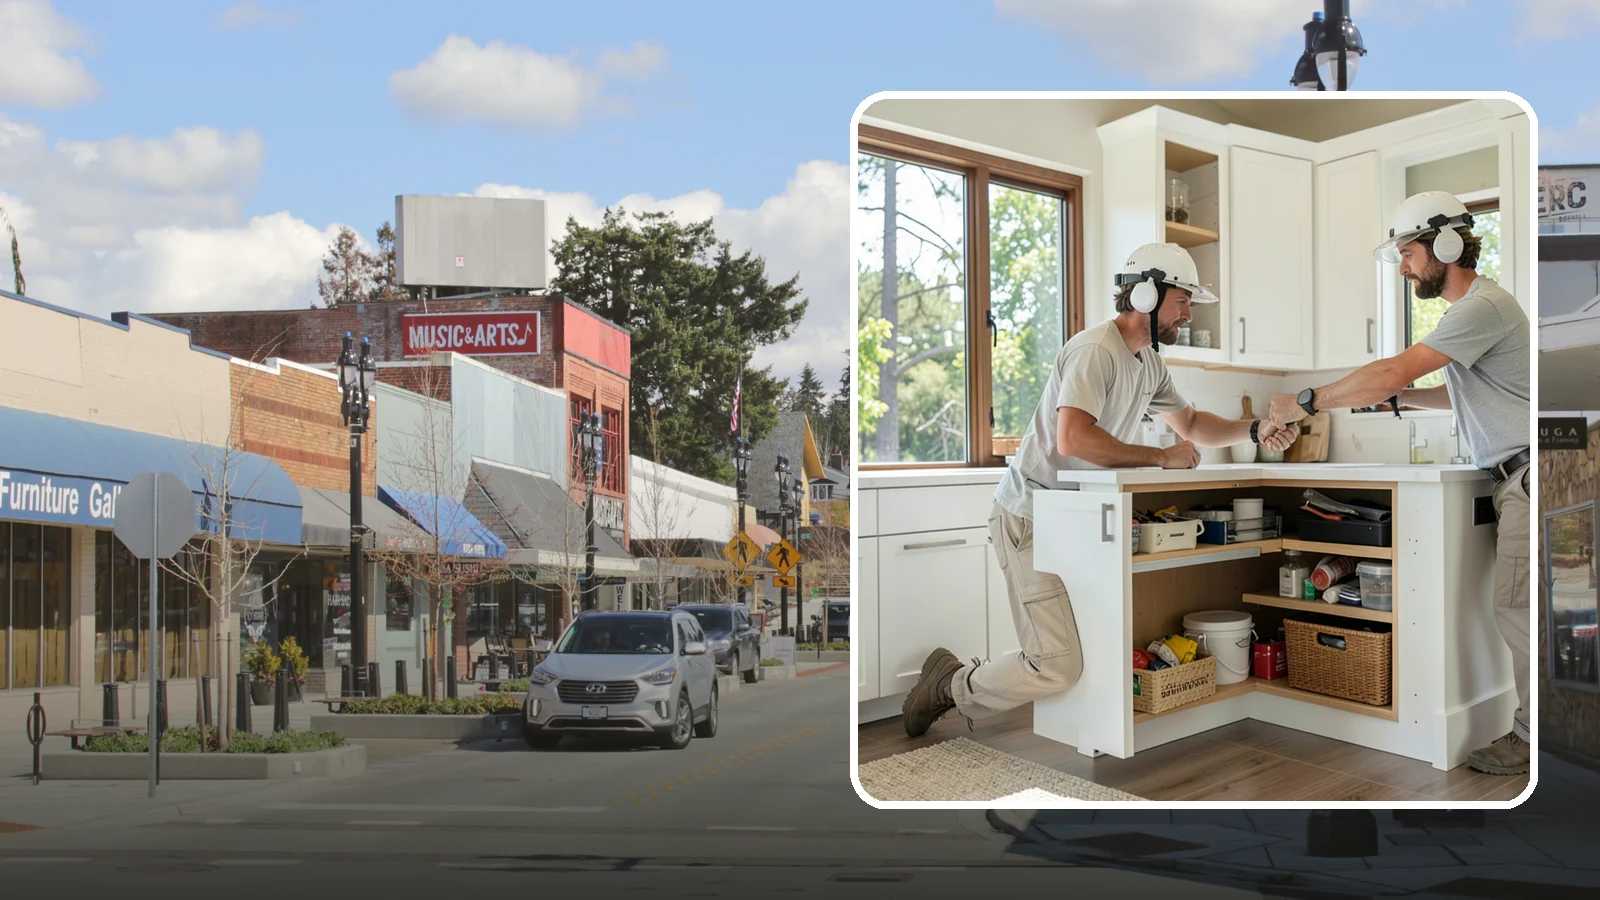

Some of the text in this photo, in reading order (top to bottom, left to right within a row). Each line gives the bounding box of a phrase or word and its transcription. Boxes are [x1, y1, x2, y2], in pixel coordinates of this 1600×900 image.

[1540, 428, 1577, 436] UGA
[0, 471, 121, 519] Furniture Gal
[453, 563, 479, 574] SUSHI
